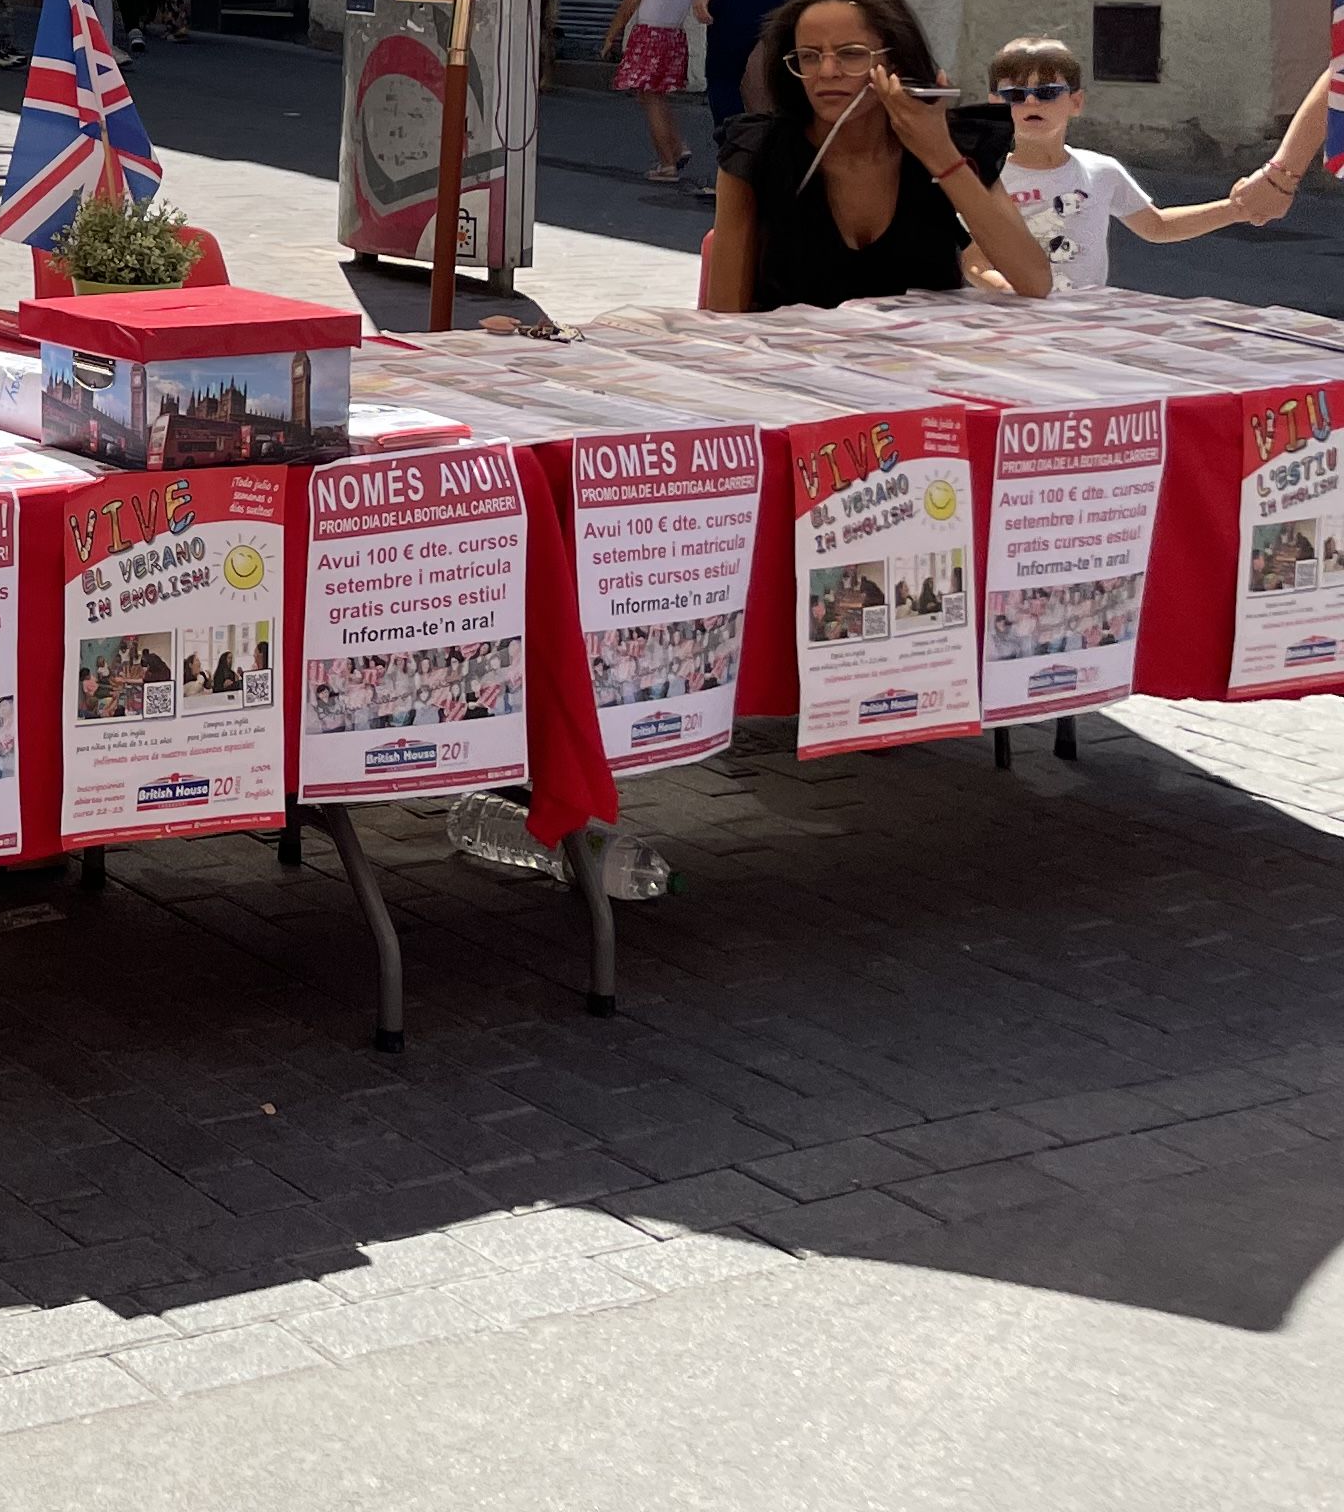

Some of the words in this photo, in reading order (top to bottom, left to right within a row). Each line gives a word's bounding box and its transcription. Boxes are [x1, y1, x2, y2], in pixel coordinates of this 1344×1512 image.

[1004, 412, 1092, 455] NOMÉS
[1104, 410, 1159, 447] AVUI!
[1251, 390, 1331, 461] VIU
[580, 434, 676, 481] NOMÉS
[691, 436, 754, 473] AVUI!
[797, 422, 899, 500] VIVE
[317, 461, 424, 512] NOMÉS
[440, 455, 511, 497] AVUI!
[69, 479, 195, 563] VIVE
[320, 519, 360, 534] PROMO
[362, 516, 380, 530] DIA
[382, 515, 396, 529] DE
[399, 512, 413, 526] LA
[414, 506, 453, 526] BOTIGA
[455, 506, 469, 519] AL
[470, 496, 516, 517] CARRER!
[82, 566, 112, 596] EL
[120, 537, 206, 585] VERANO
[318, 551, 360, 571] Avui
[367, 546, 397, 565] 100
[403, 544, 414, 561] €
[420, 541, 452, 559] dte.
[459, 533, 518, 554] cursos
[87, 598, 111, 623] IN
[119, 567, 211, 613] ENGLISH!
[325, 572, 412, 595] setembre
[419, 569, 423, 585] i
[429, 559, 511, 583] matrícula
[330, 601, 383, 624] gratis
[390, 595, 452, 615] cursos
[458, 584, 506, 606] estiu!
[462, 611, 494, 630] ara!
[441, 742, 461, 761] 20
[139, 786, 172, 801] British
[175, 784, 208, 797] House
[214, 776, 233, 796] 20
